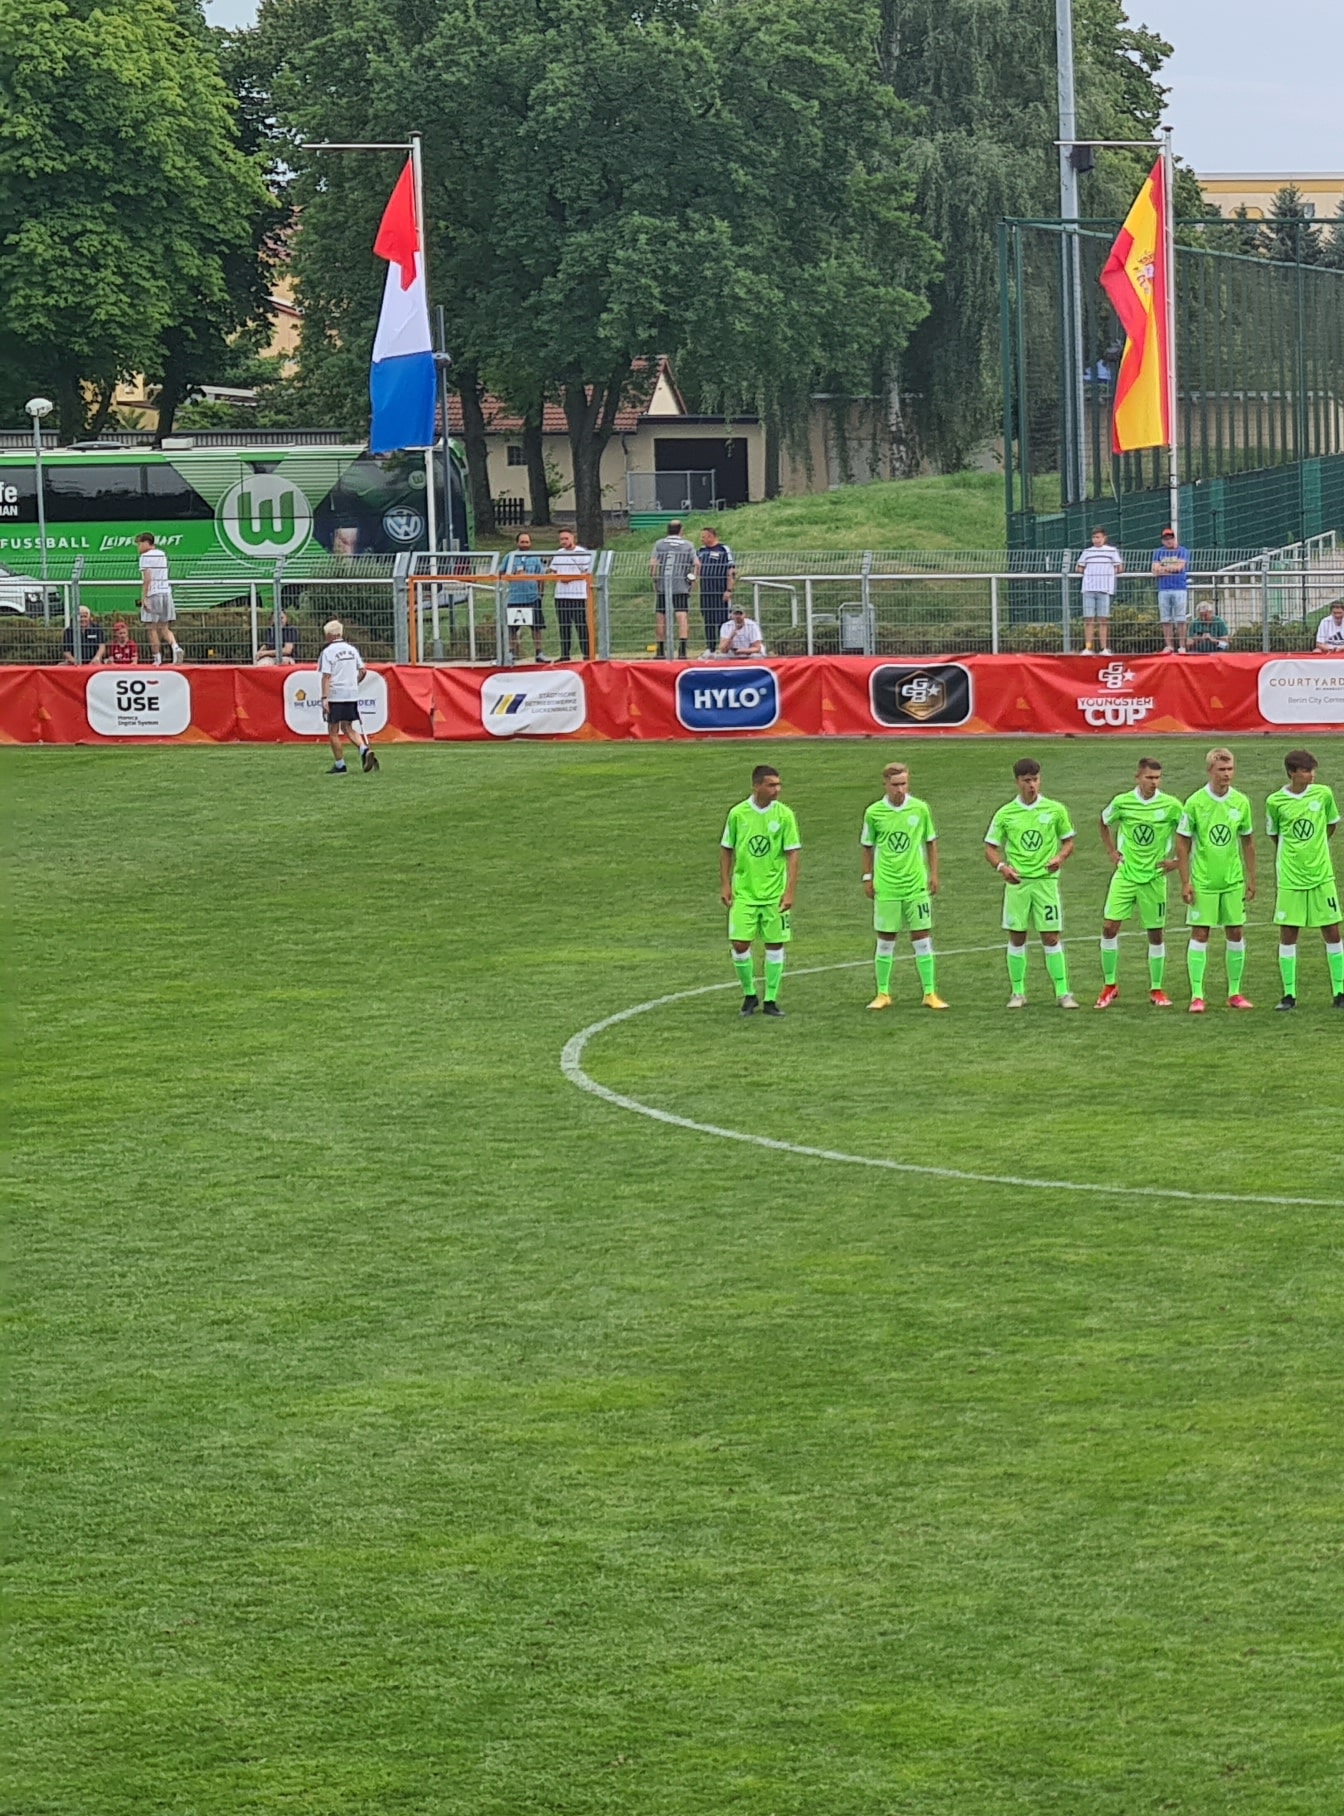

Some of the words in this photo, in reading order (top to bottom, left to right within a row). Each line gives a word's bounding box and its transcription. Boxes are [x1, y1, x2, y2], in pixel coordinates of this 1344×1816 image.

[116, 680, 146, 695] SO
[117, 697, 159, 711] USE
[1080, 698, 1151, 707] YOUNGSTER
[1085, 708, 1146, 726] CUP
[917, 903, 930, 919] 14
[1327, 897, 1337, 912] 4
[1045, 905, 1059, 921] 21
